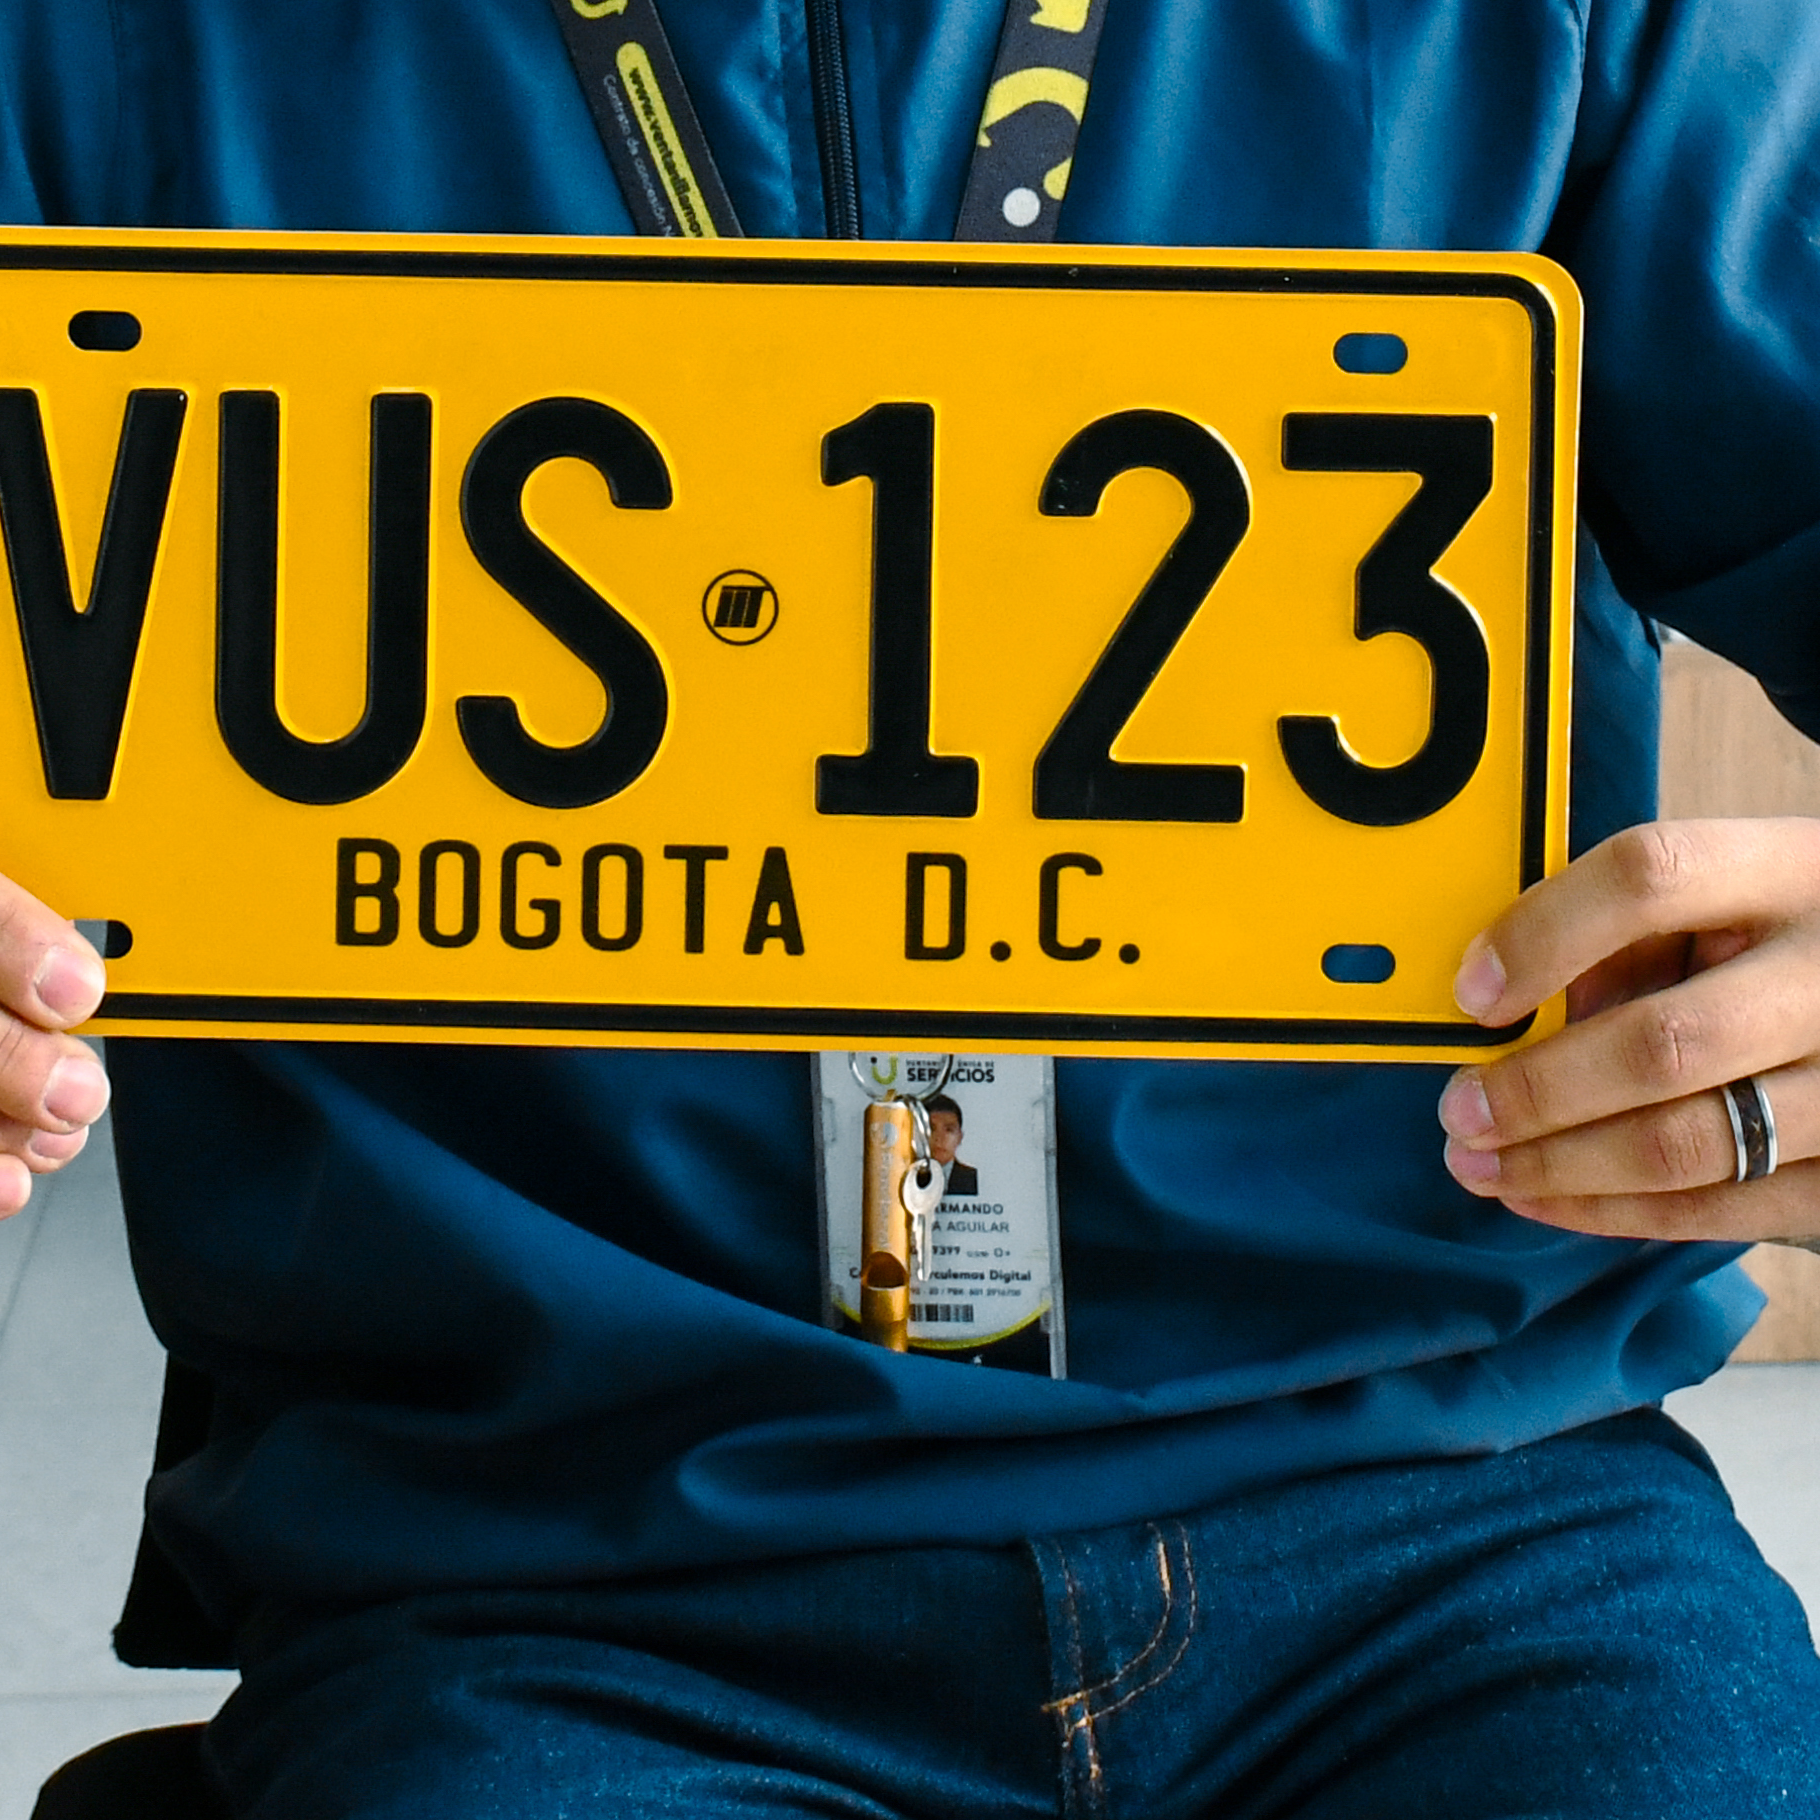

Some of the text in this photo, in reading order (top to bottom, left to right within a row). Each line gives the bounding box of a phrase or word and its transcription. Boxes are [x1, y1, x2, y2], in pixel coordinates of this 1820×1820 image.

[816, 403, 1493, 827] 123
[337, 838, 1141, 964] BOGOTA D.C.
[907, 1068, 995, 1083] SERICIOS
[947, 1220, 1010, 1233] AGUILAR
[929, 1268, 1032, 1284] rculemos Digital
